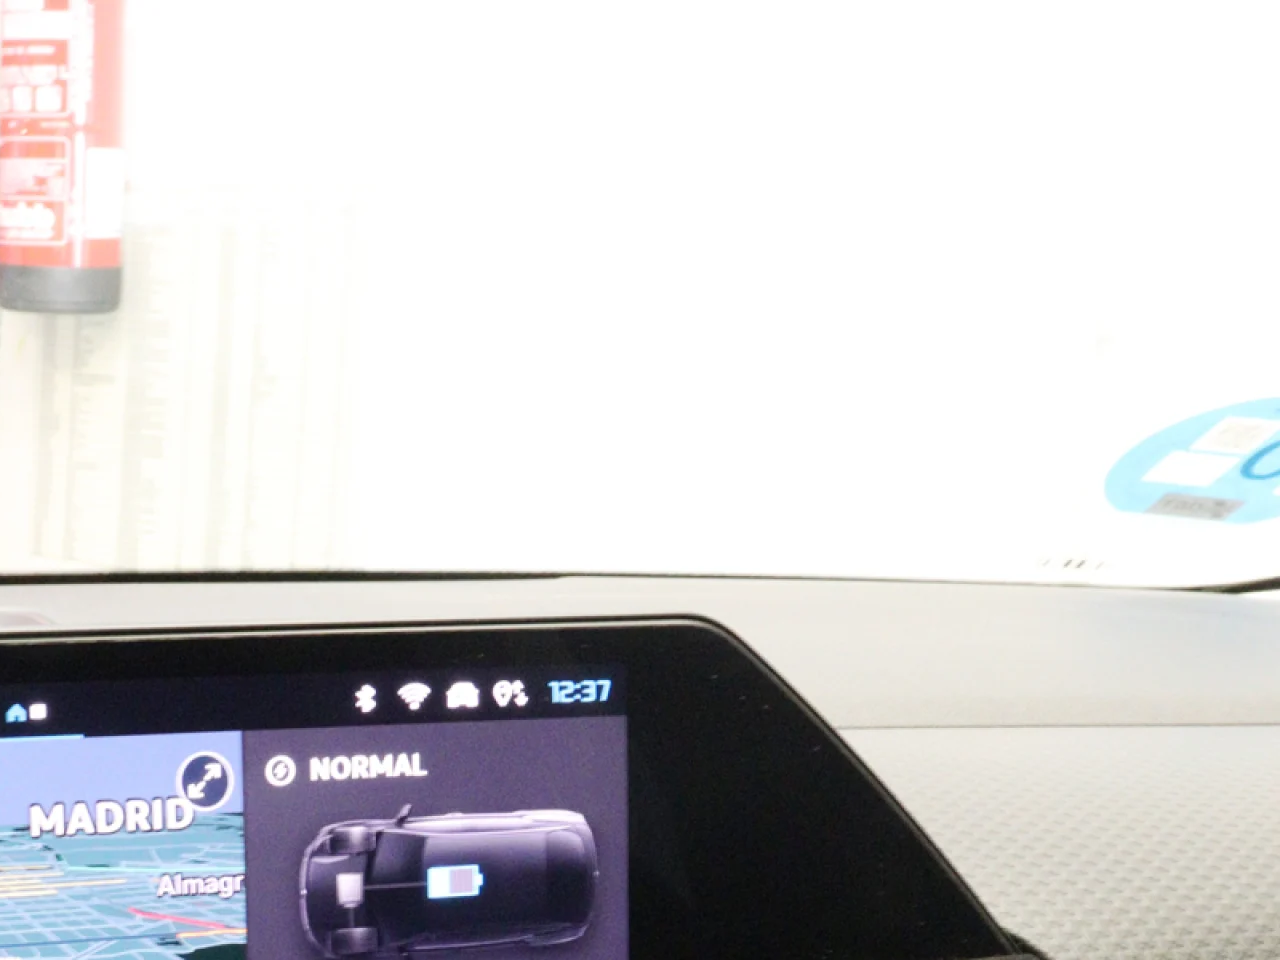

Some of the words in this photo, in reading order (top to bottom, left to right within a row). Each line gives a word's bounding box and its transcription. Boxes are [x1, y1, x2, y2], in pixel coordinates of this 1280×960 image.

[547, 679, 612, 704] 12:37
[309, 752, 428, 781] NORMAL
[28, 796, 195, 838] MADRID
